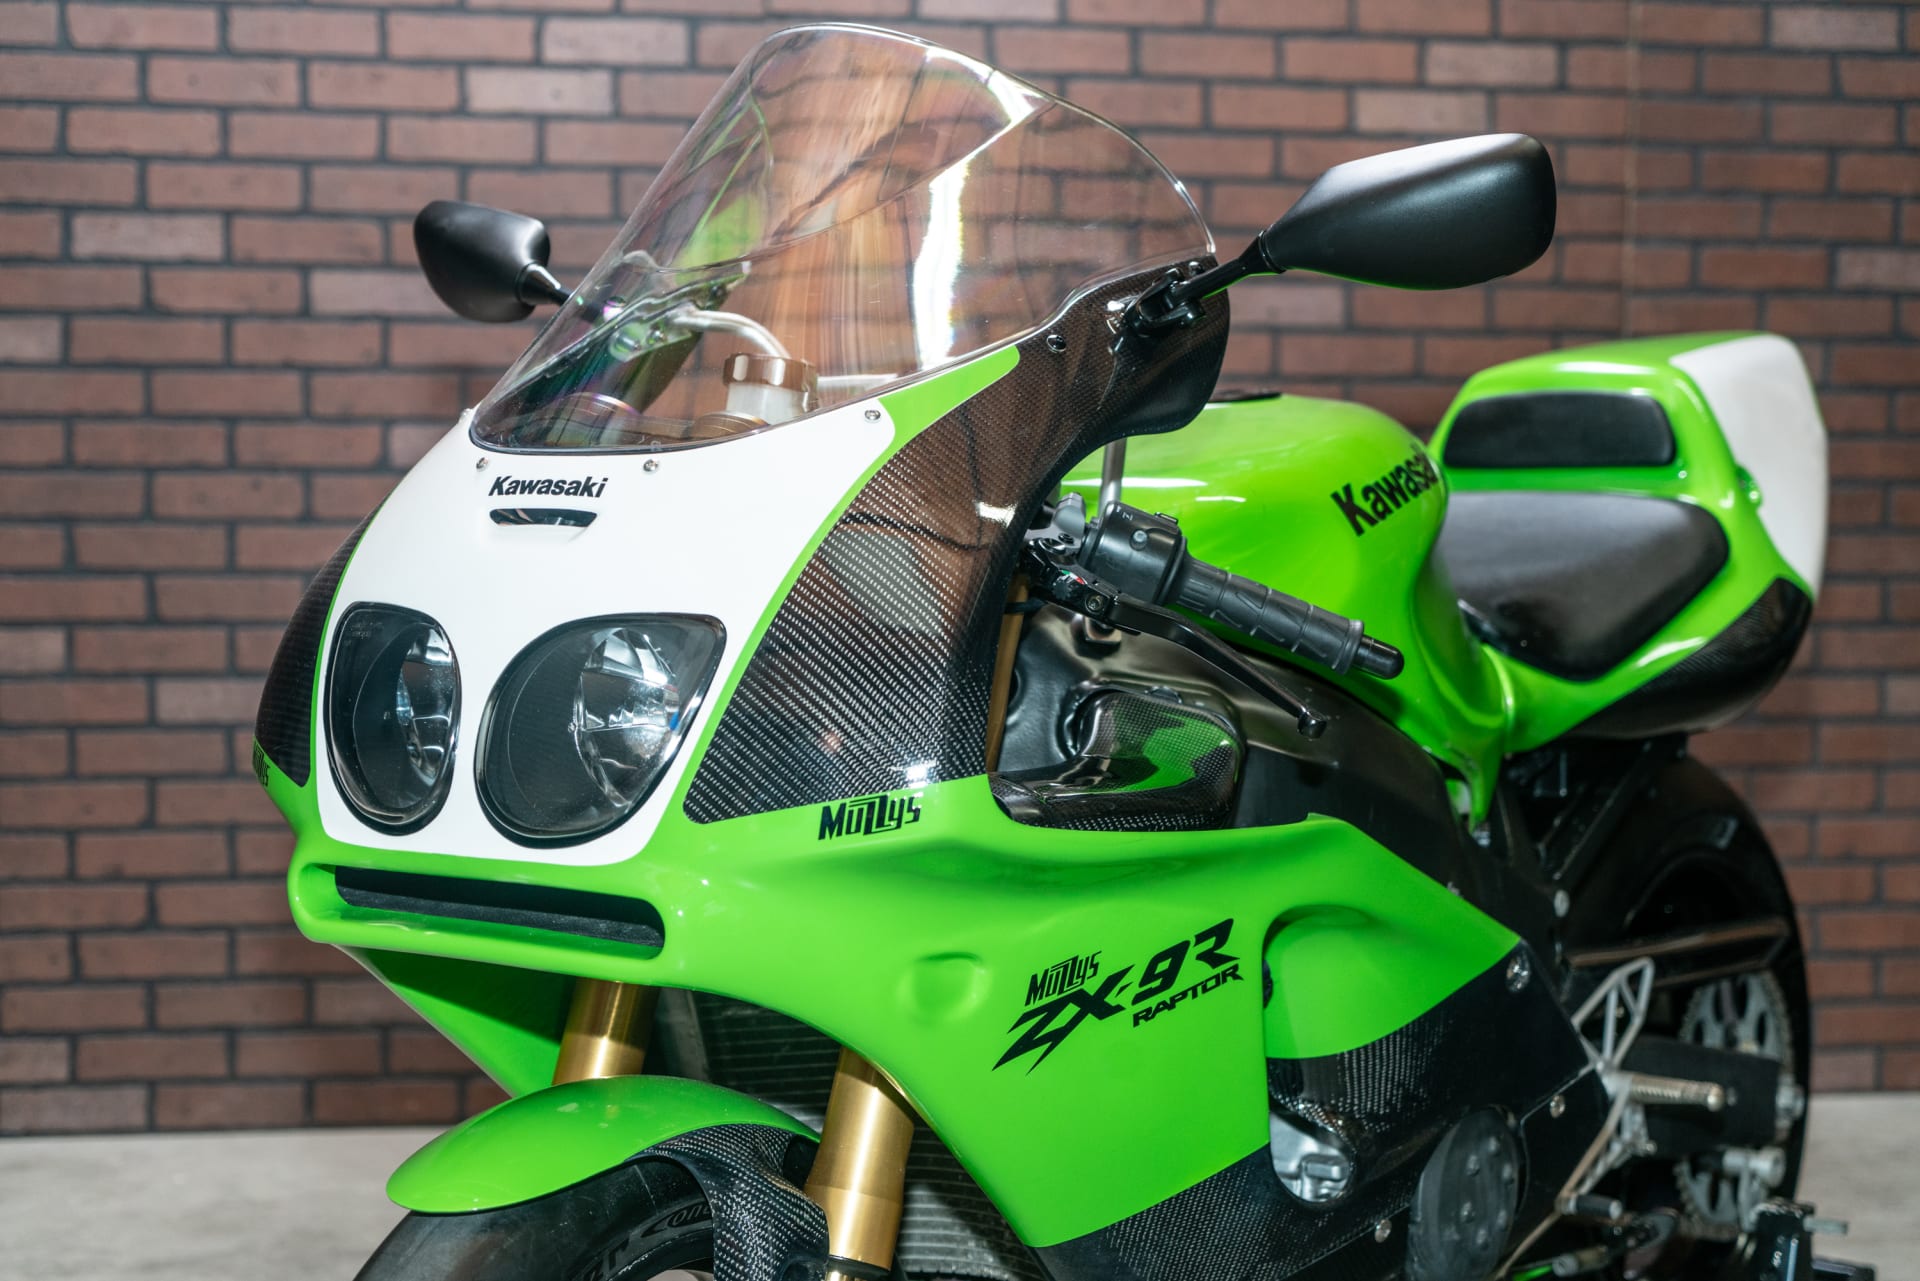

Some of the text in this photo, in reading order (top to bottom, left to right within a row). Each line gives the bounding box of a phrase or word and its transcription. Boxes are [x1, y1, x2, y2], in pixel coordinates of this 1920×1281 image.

[488, 475, 609, 498] Kawasaki
[991, 918, 1240, 1077] ZX-9R
[1133, 963, 1244, 1028] RAPTOR
